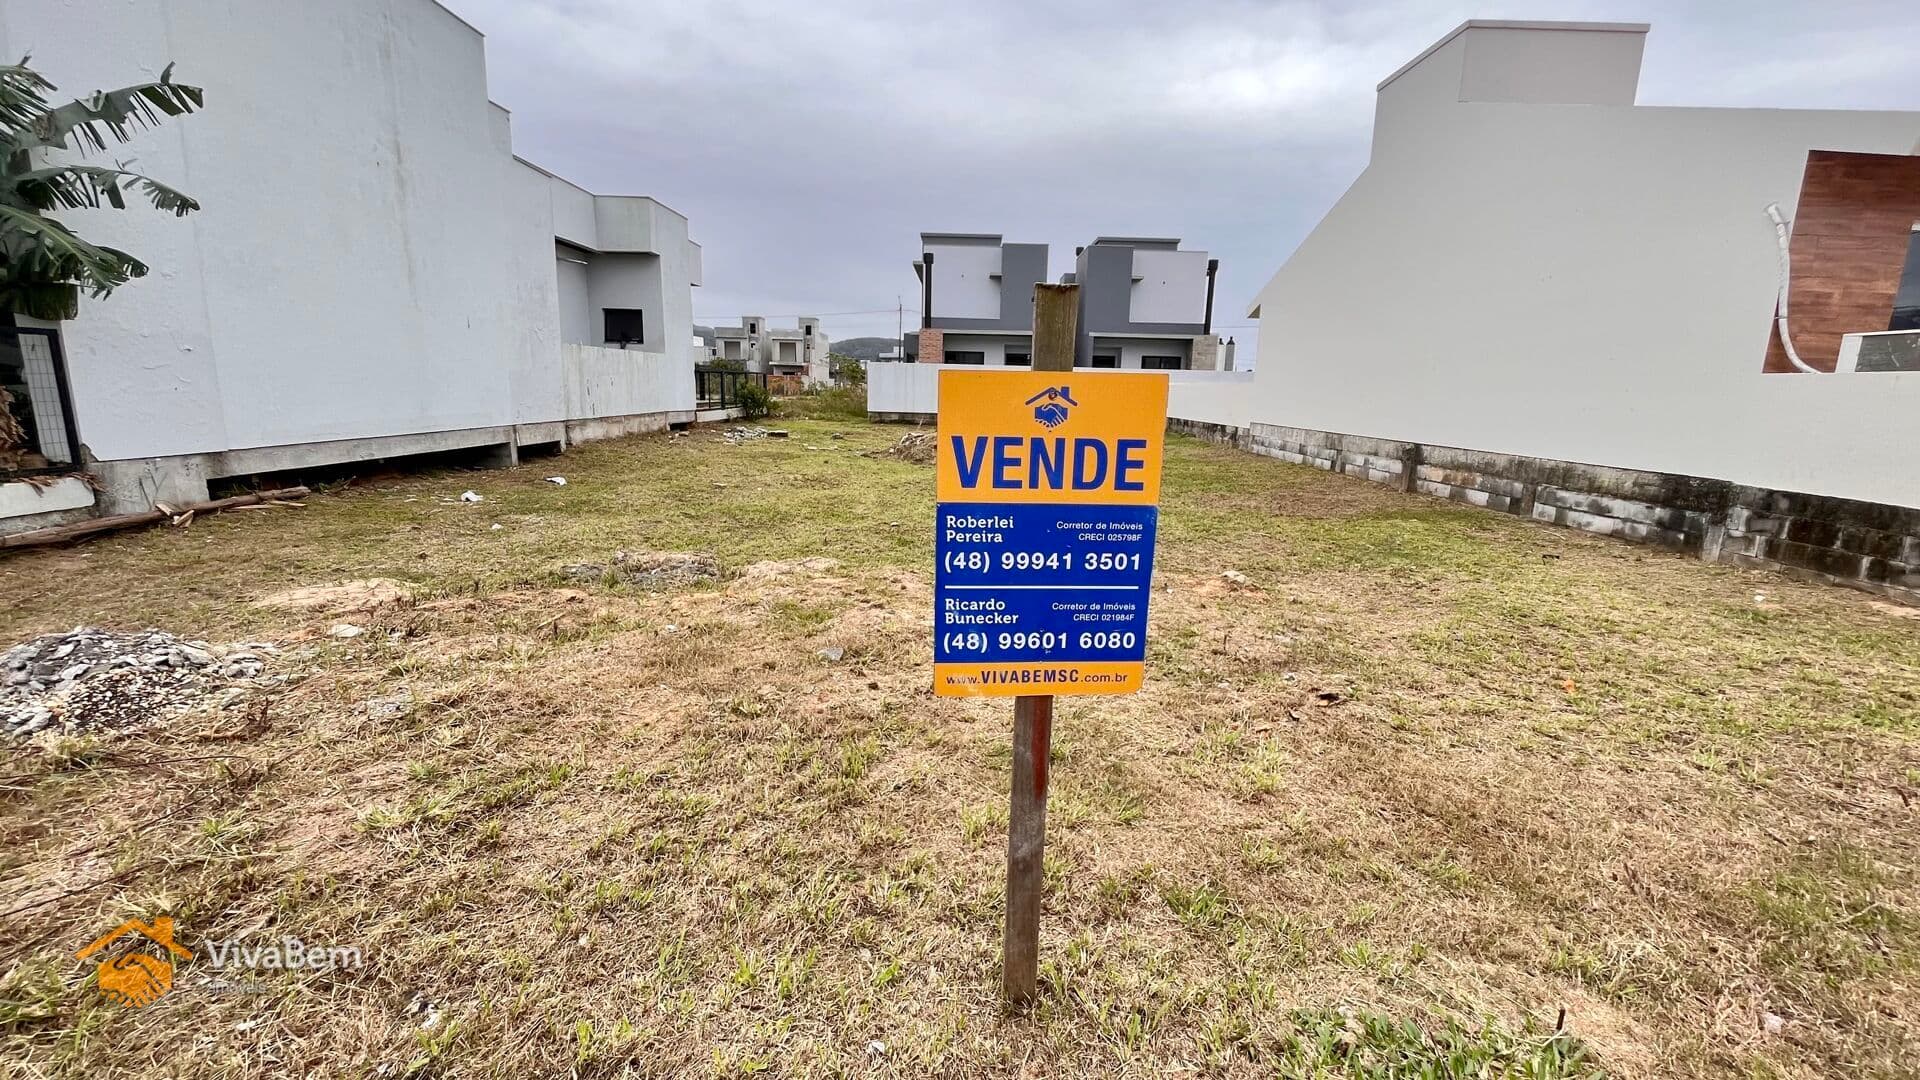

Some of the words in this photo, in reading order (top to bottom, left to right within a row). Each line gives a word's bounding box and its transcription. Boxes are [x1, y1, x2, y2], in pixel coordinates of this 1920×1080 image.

[951, 436, 1147, 490] VENDE
[946, 516, 1014, 529] Roberlei
[1056, 521, 1093, 530] Corretor
[1095, 522, 1107, 530] de
[1109, 522, 1143, 530] Imóveis
[946, 530, 1003, 542] Pereira
[1078, 533, 1105, 541] CRECI
[1107, 533, 1142, 541] 025798F
[944, 551, 990, 573] (48)
[1001, 552, 1072, 570] 99941
[1084, 553, 1140, 570] 3501
[945, 599, 1005, 611] Ricardo
[1052, 602, 1088, 611] Corretor
[1090, 603, 1101, 611] de
[1103, 602, 1136, 611] Imóveis
[945, 613, 1019, 624] Bunecker
[943, 633, 988, 653] (48)
[999, 633, 1067, 649] 99601
[1079, 632, 1135, 649] 6080
